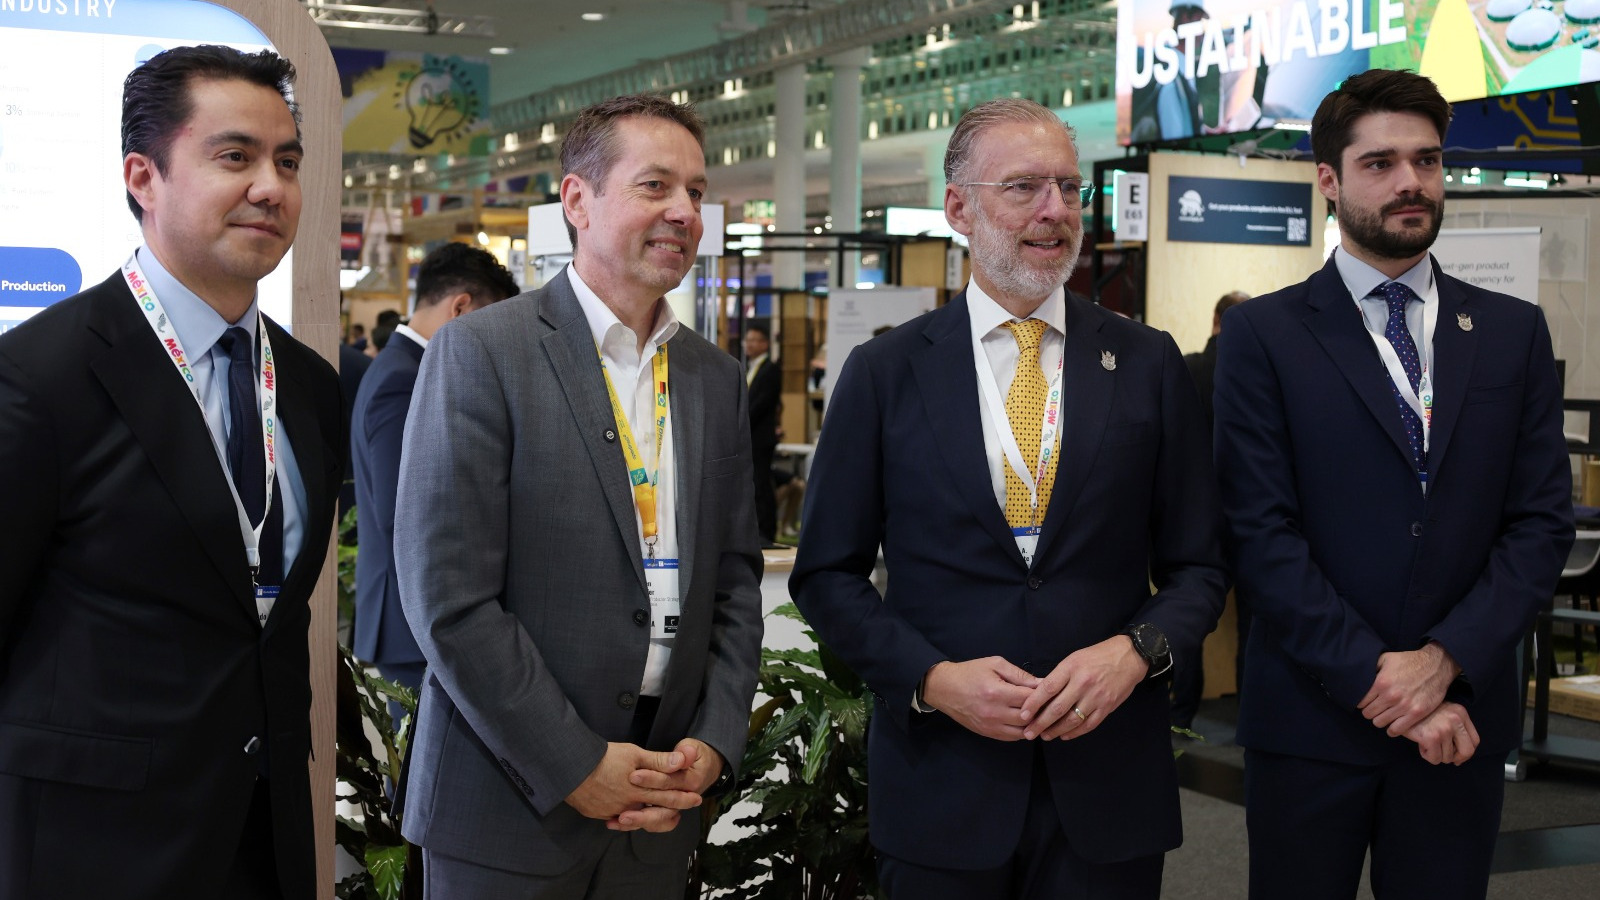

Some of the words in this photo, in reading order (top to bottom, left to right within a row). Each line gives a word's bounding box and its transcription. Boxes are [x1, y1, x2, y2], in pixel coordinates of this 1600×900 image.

[1130, 184, 1140, 204] E
[1476, 261, 1510, 271] product
[1, 280, 66, 292] Production
[127, 271, 155, 312] México
[164, 338, 194, 383] México
[262, 346, 274, 391] México
[1046, 390, 1059, 425] México
[265, 418, 274, 464] México
